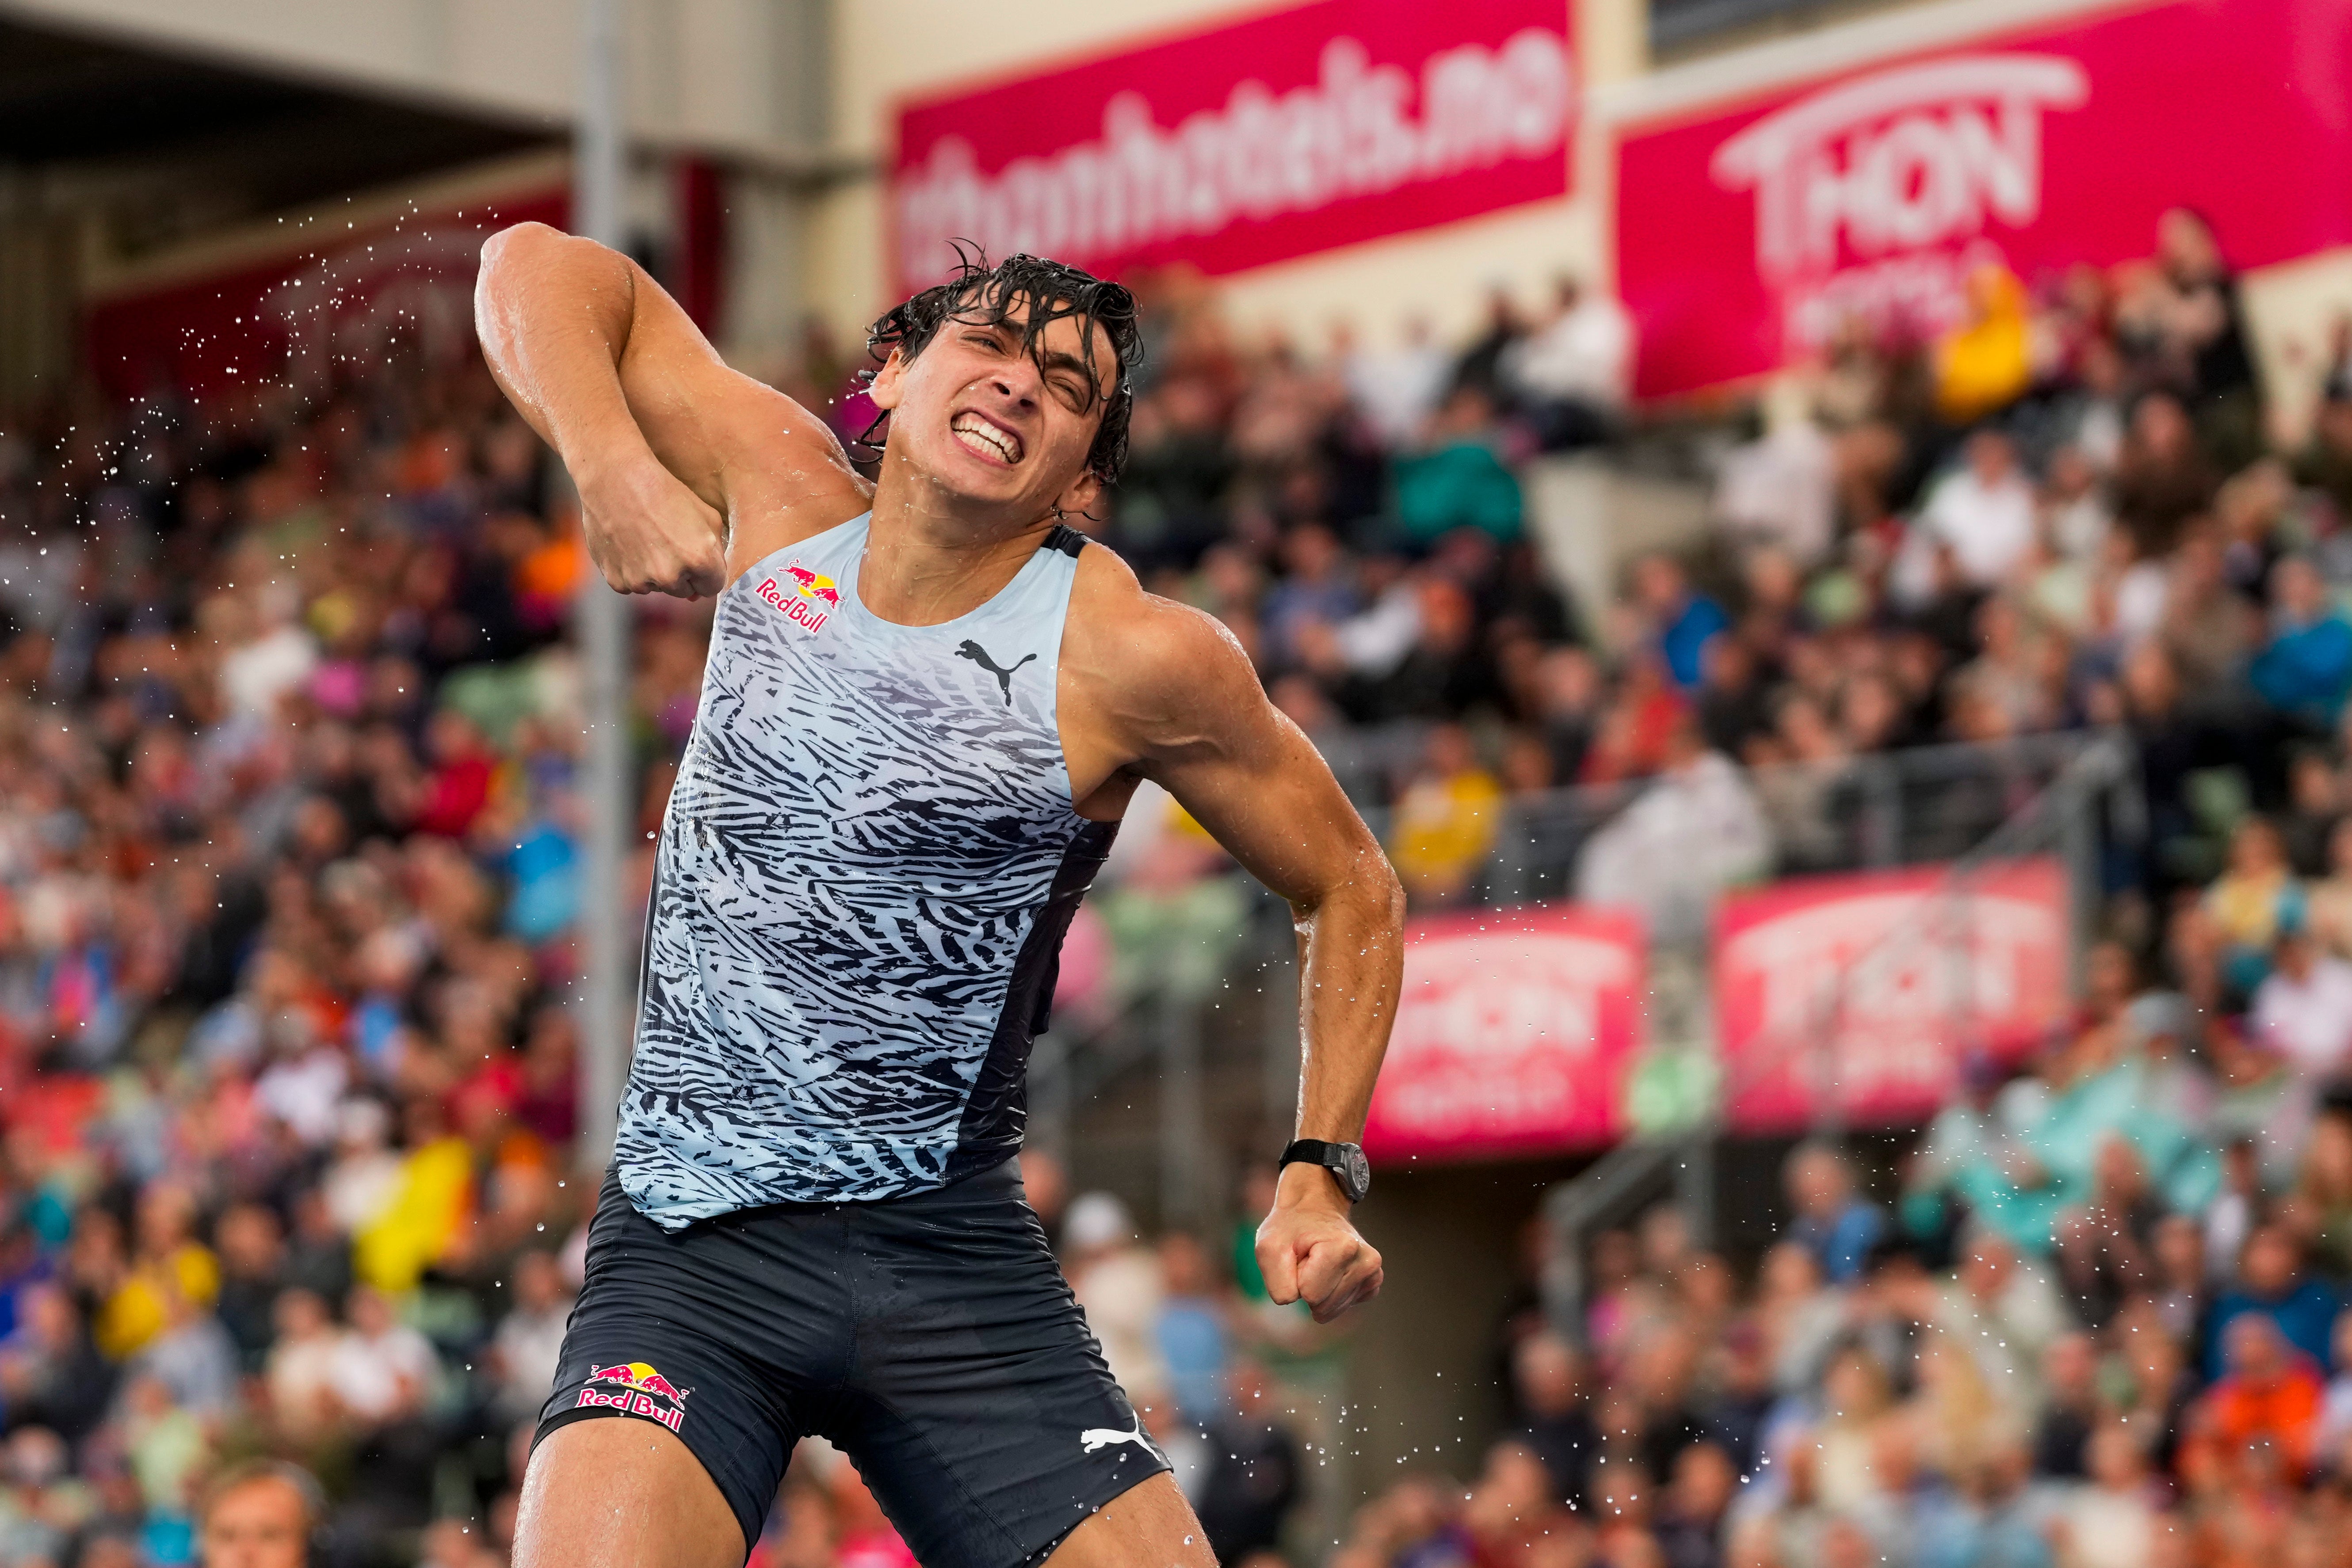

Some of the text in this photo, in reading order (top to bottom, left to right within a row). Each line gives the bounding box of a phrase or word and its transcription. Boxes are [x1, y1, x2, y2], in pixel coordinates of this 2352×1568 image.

[1709, 53, 2091, 275] THON
[577, 1389, 683, 1432] Red Bull
